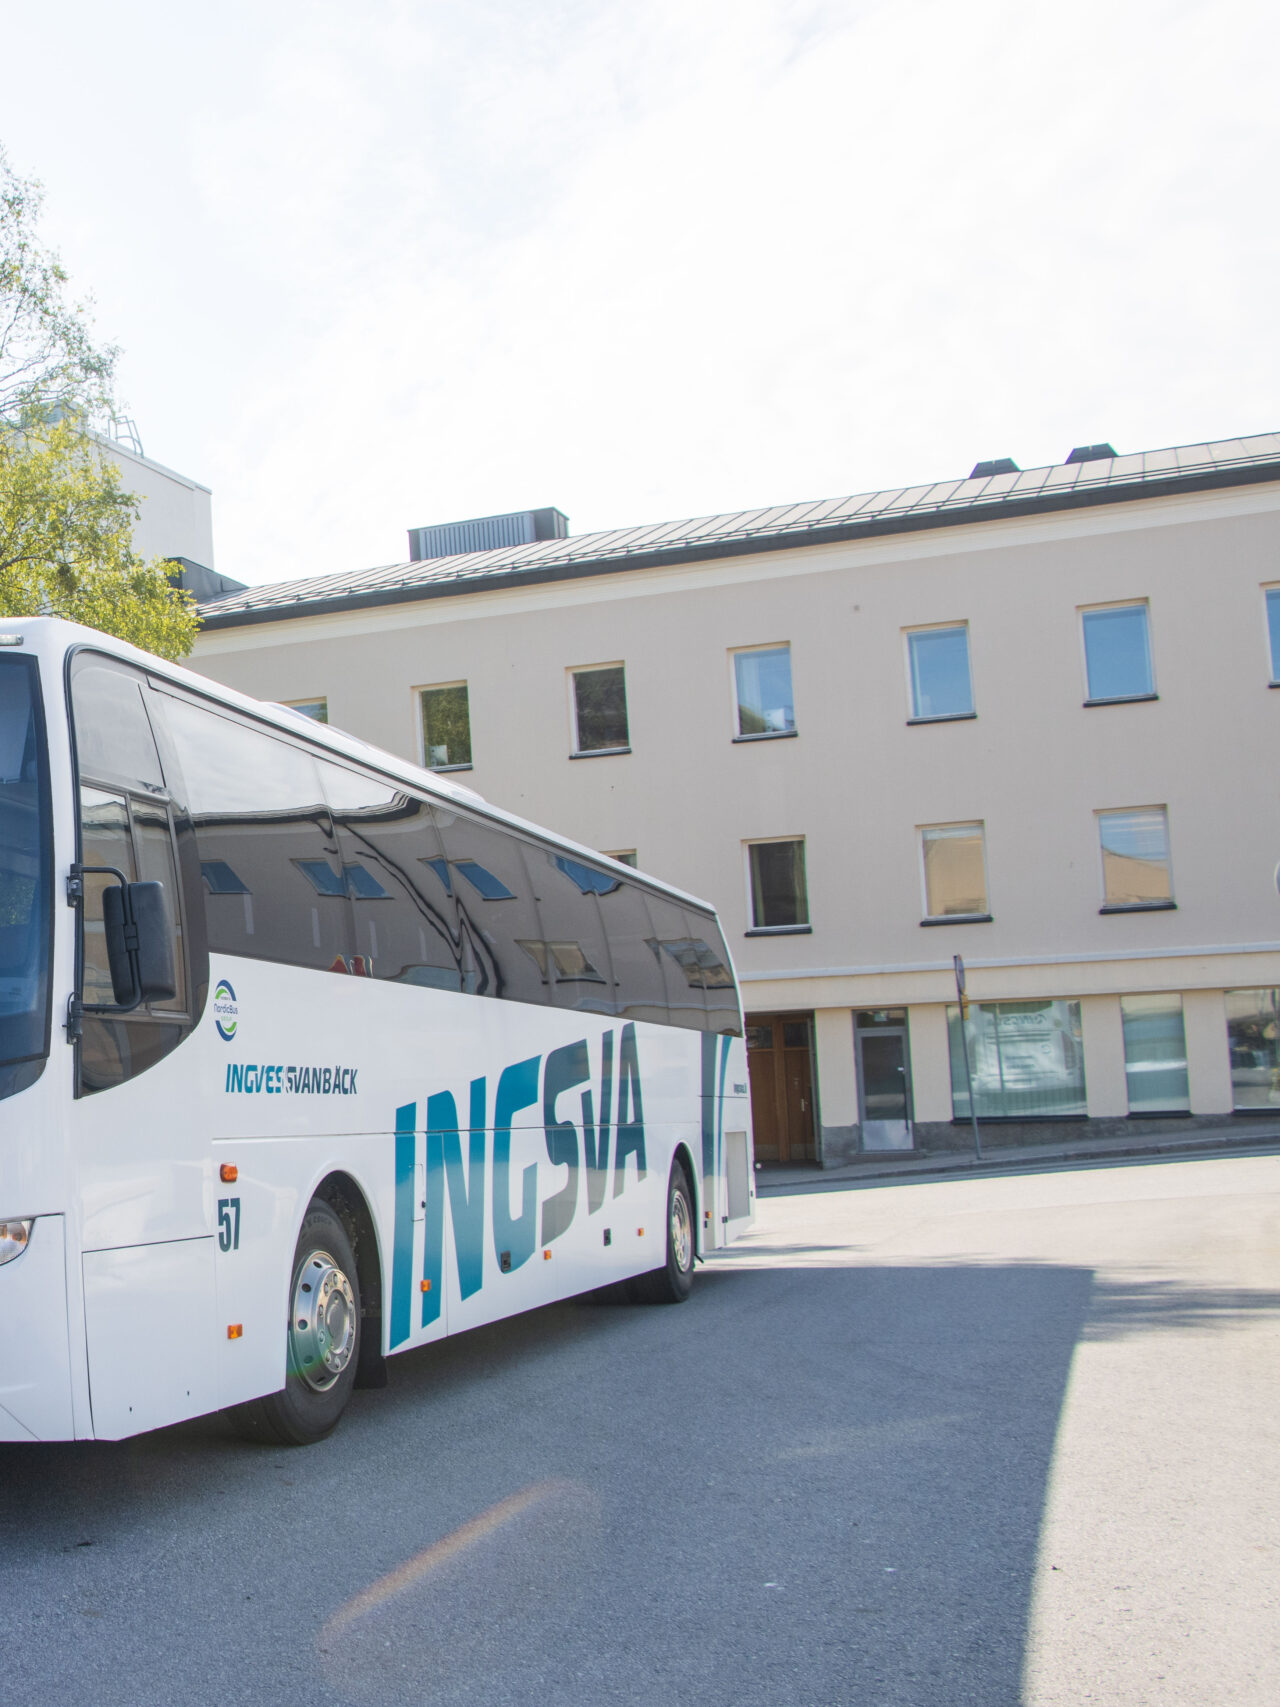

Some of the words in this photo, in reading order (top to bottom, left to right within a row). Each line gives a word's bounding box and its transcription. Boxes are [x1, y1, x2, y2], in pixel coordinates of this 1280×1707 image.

[225, 1063, 284, 1094] INGVES
[286, 1065, 358, 1095] SVANBÄCK
[389, 1021, 648, 1352] INGSVA
[217, 1197, 241, 1252] 57
